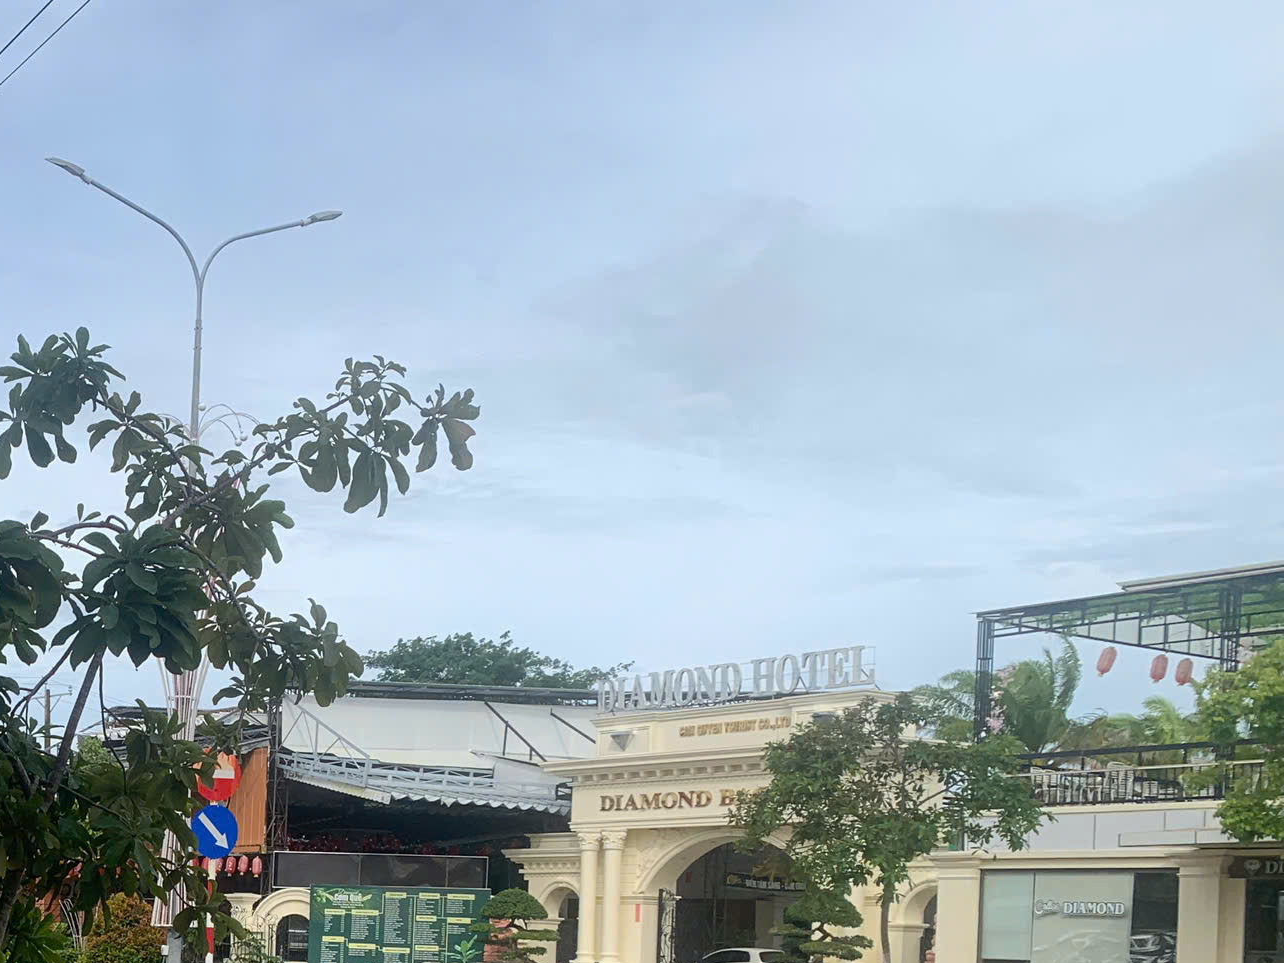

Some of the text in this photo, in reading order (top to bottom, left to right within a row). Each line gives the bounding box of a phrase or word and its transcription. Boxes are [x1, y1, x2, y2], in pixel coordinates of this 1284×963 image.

[597, 646, 875, 712] DIAMOND HOTEL
[600, 790, 713, 812] DIAMOND
[1063, 901, 1125, 915] DIAMOND
